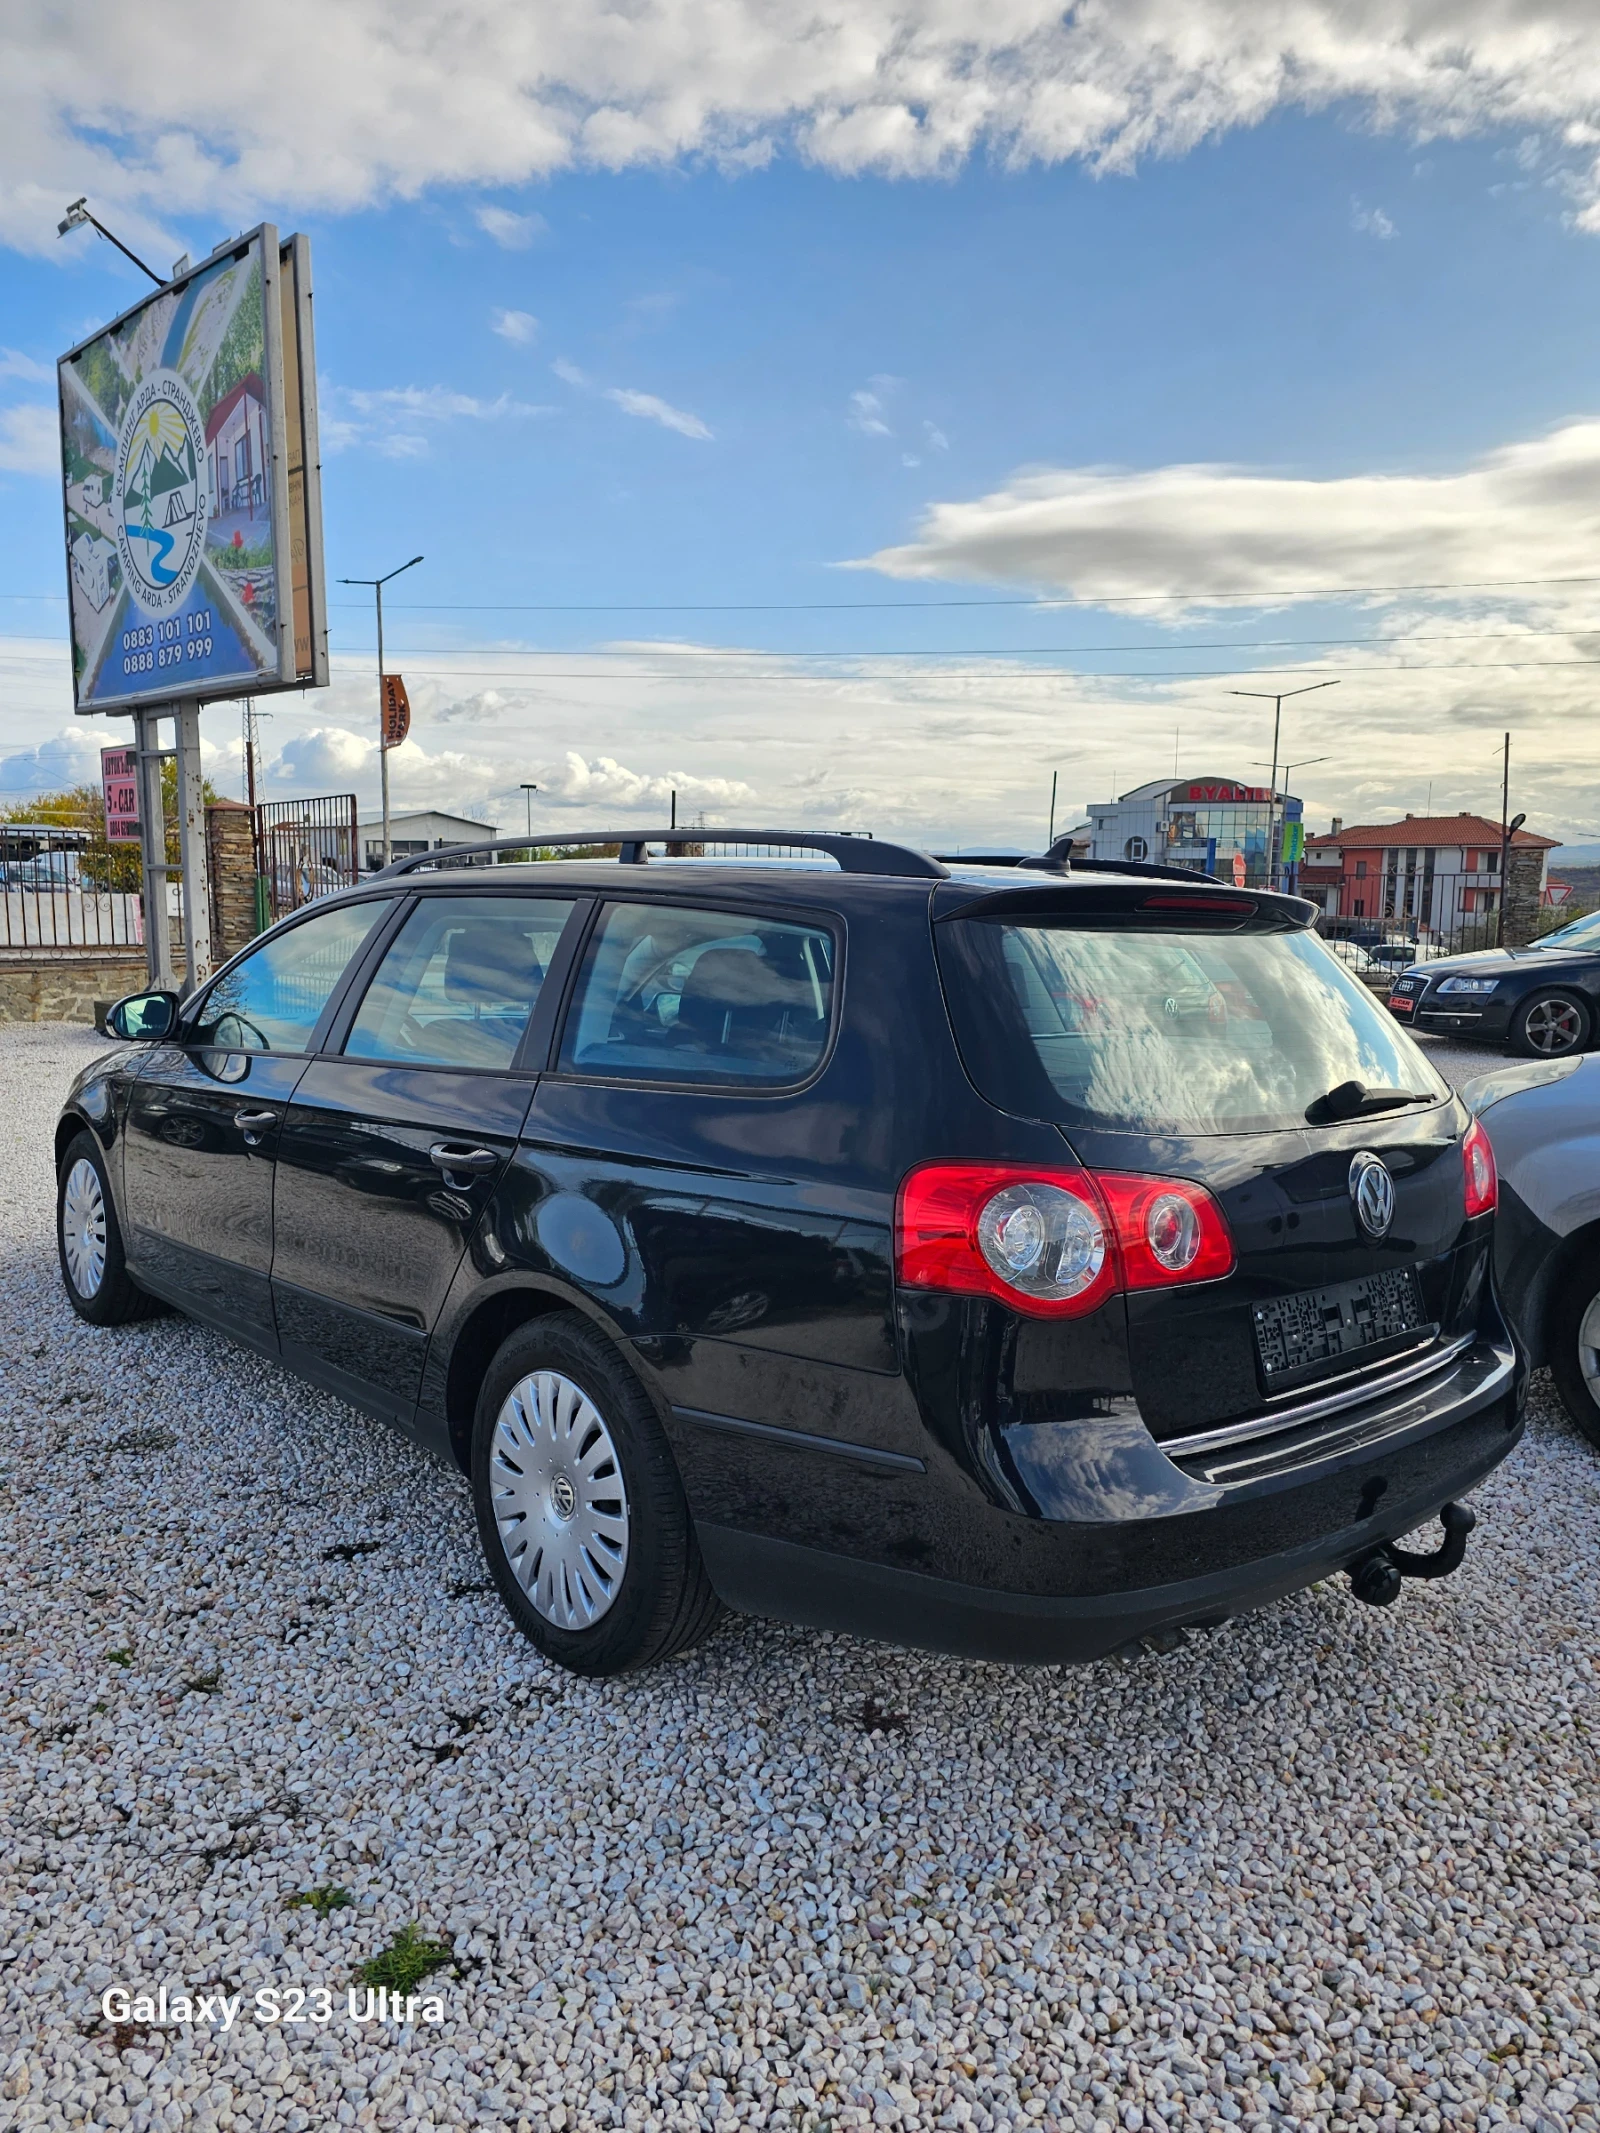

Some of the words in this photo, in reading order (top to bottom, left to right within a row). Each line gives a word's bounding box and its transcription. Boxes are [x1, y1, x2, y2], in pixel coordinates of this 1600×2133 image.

[116, 408, 136, 497] КЪМПИНГ
[136, 382, 157, 415] АРДА
[162, 380, 204, 463] СТРАНДЖЕВО
[117, 524, 142, 594] CAMPING
[141, 588, 162, 608] ARDA
[168, 494, 206, 604] STRANDZHEVO
[123, 625, 153, 651] 0883
[158, 617, 181, 644] 101
[187, 609, 212, 635] 101
[123, 651, 154, 676] 0888
[158, 644, 182, 668] 879
[187, 637, 213, 660] 999
[387, 681, 397, 739] HOLIDAY
[395, 703, 406, 738] PARK
[118, 788, 135, 812] CAR
